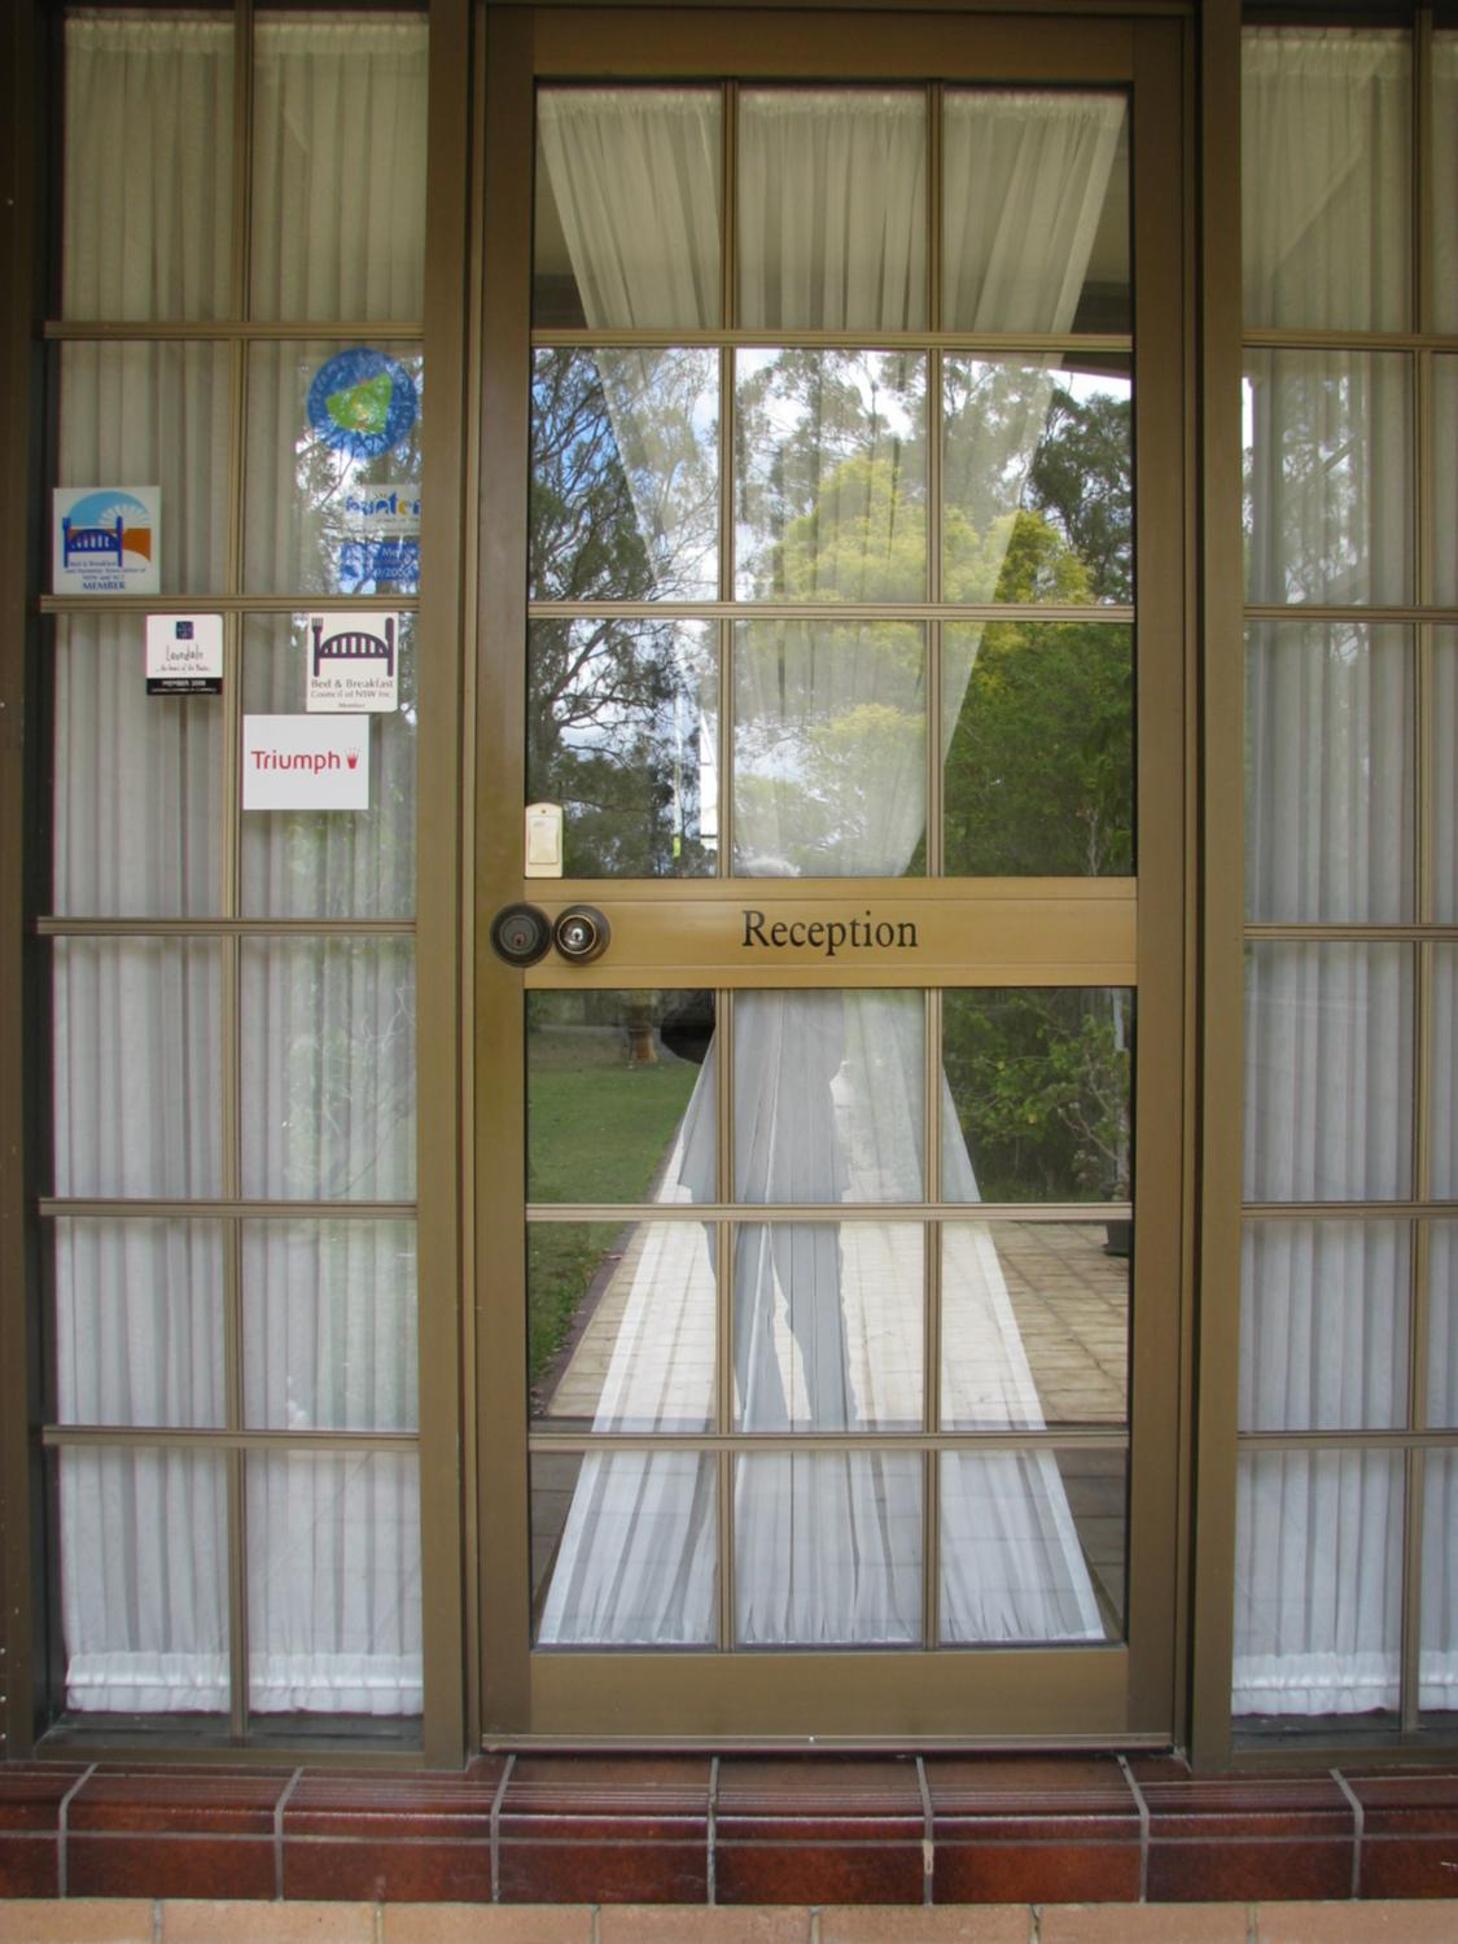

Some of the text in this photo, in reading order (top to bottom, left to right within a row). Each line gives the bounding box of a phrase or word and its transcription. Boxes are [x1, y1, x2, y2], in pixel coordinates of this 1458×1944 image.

[83, 582, 126, 590] MEMBER
[311, 677, 394, 689] Bed & Breakfast
[250, 748, 341, 775] Triumph
[741, 909, 919, 957] Reception
